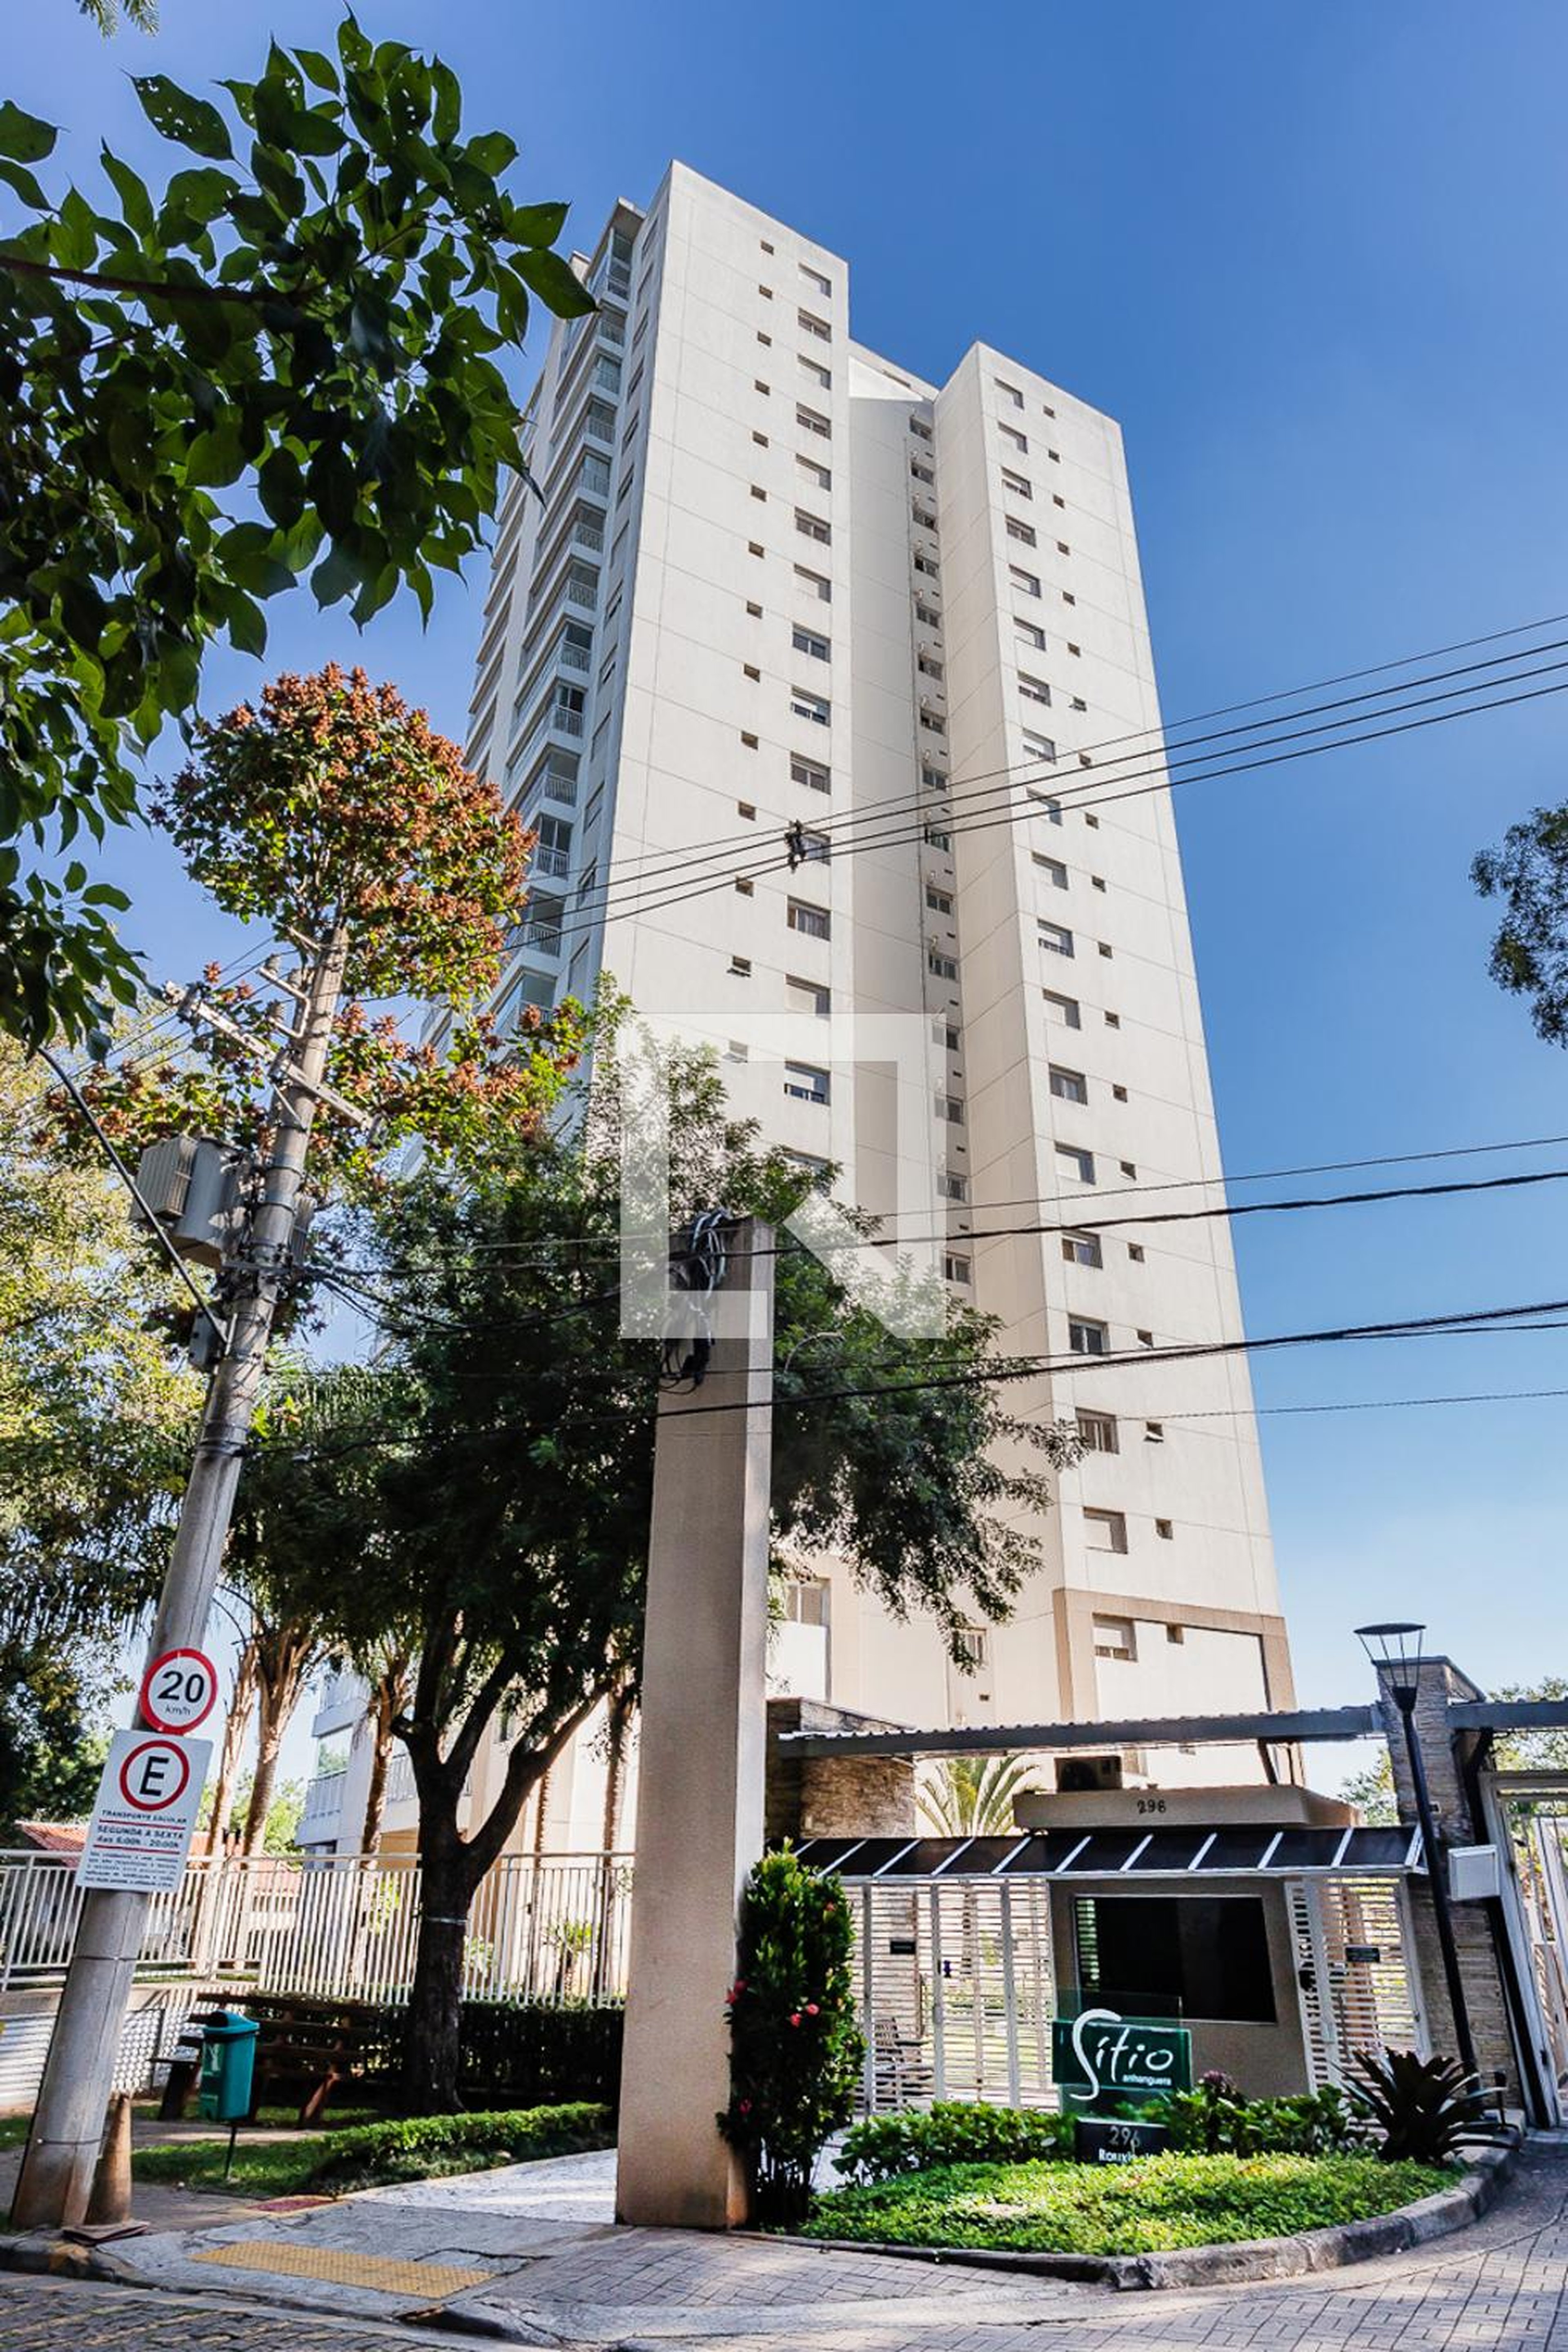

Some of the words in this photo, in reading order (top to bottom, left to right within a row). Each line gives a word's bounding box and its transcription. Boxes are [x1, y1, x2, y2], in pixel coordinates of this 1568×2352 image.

[158, 1670, 204, 1703] 20
[165, 1704, 191, 1715] km/h
[139, 1755, 169, 1797] E
[1137, 1799, 1166, 1814] 296
[102, 1810, 151, 1820] TRANSPORTE
[98, 1825, 142, 1836] SEGUNDA
[154, 1831, 183, 1839] SEXTA
[1109, 2125, 1140, 2147] 296
